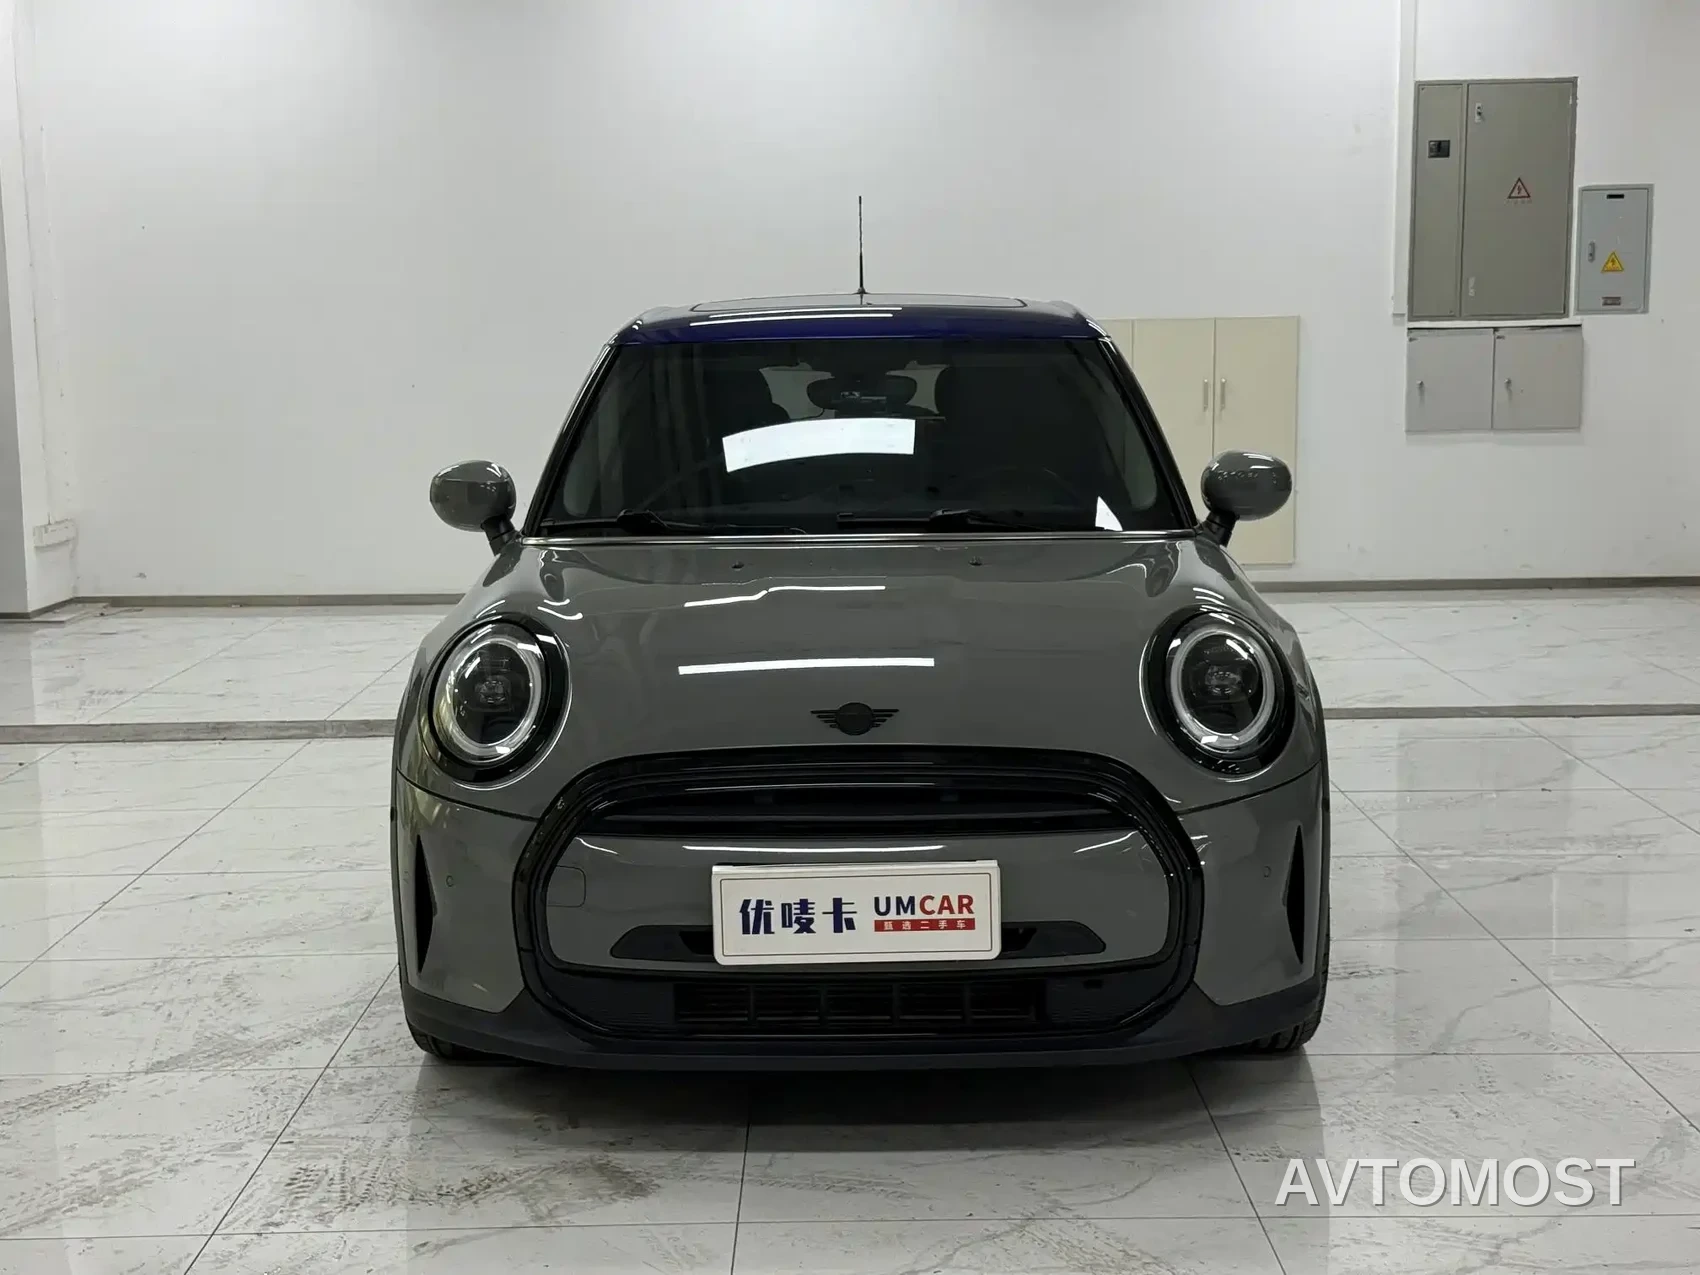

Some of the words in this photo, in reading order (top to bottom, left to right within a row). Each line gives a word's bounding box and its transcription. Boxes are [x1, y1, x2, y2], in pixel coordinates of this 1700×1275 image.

[739, 898, 857, 935] 优唛卡
[874, 894, 974, 916] UMCAR
